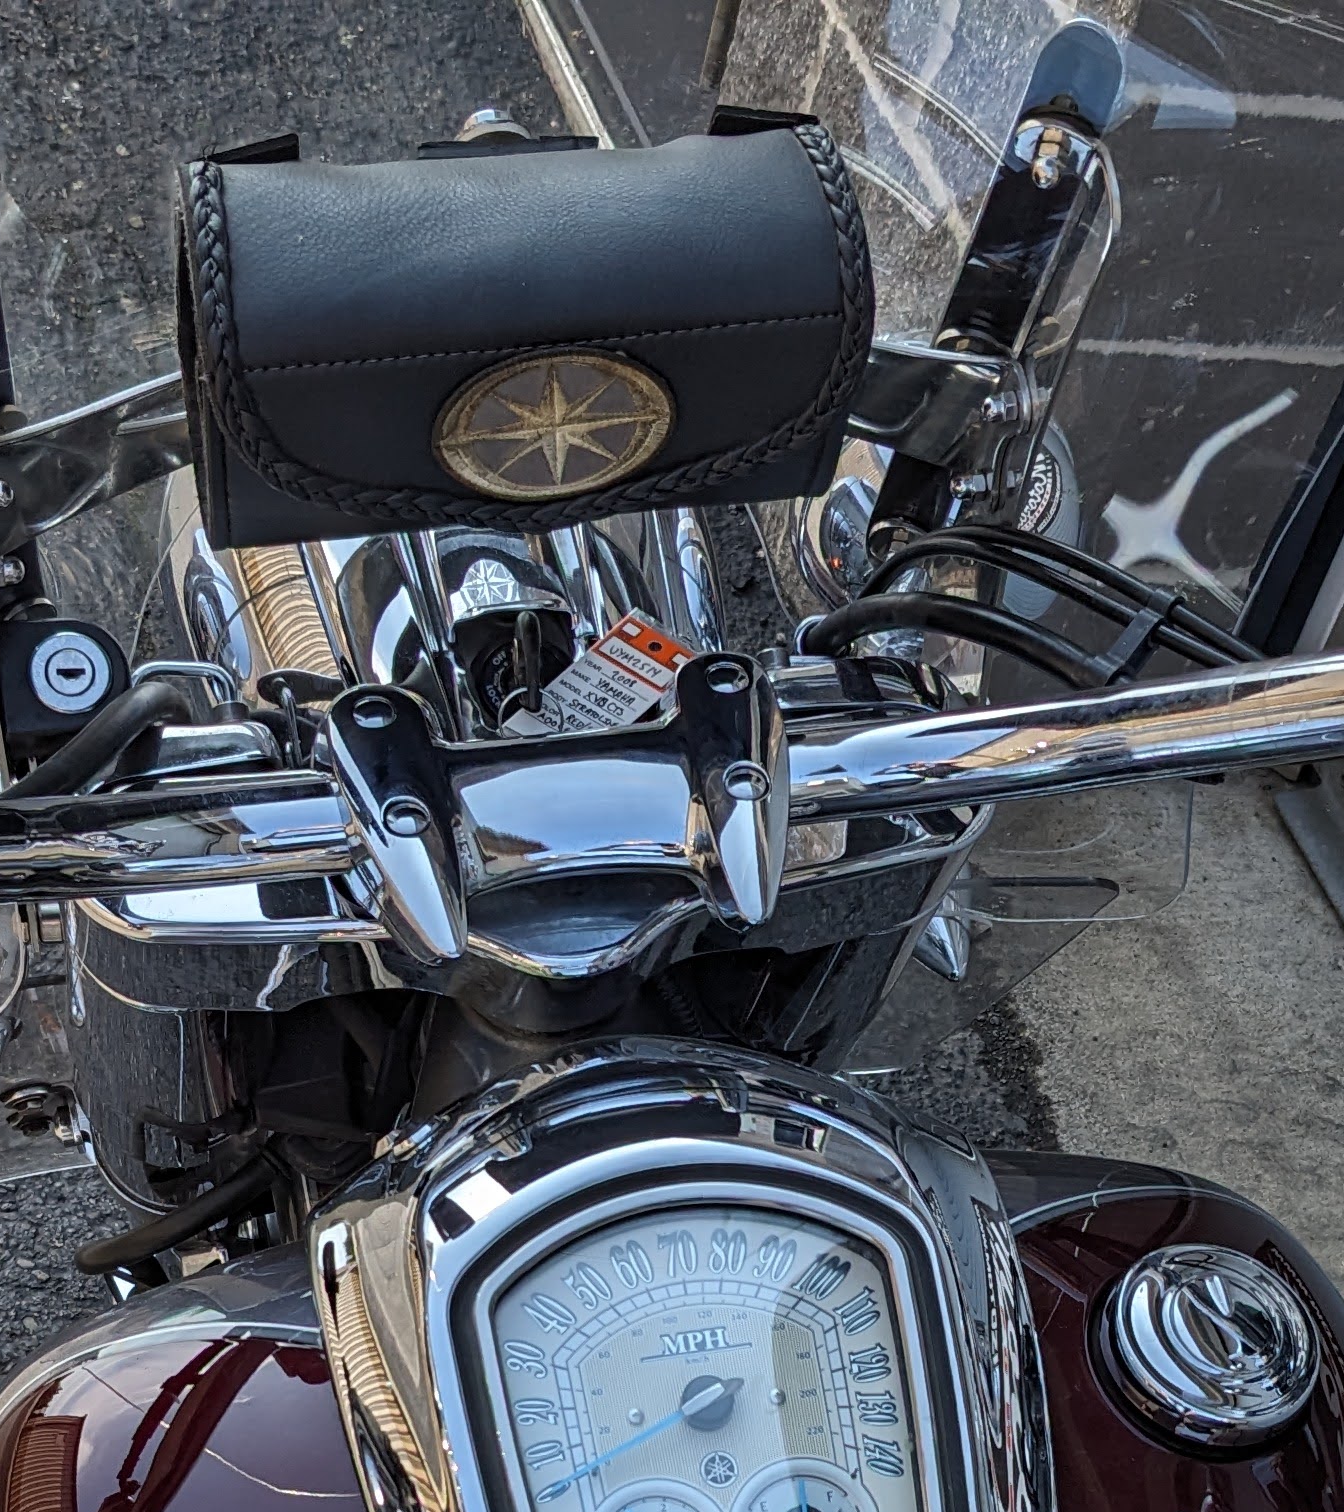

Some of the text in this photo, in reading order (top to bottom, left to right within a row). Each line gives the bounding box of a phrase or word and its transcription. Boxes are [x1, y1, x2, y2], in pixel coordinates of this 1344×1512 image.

[559, 679, 581, 696] MODEL
[571, 669, 636, 706] MAKE YAMAHA
[584, 659, 638, 688] YEAR 2008
[541, 703, 561, 717] OLOR
[610, 1240, 655, 1289] 60
[656, 1229, 698, 1279] 70
[707, 1228, 748, 1276] 80
[752, 1234, 798, 1283] 90
[560, 1262, 613, 1311] 50
[791, 1252, 852, 1301] 100
[520, 1292, 577, 1335] 40
[833, 1285, 881, 1336] 110
[503, 1339, 548, 1379] 30
[659, 1326, 729, 1356] MPH
[849, 1342, 892, 1384] 120
[799, 1388, 818, 1398] 200
[855, 1390, 899, 1427] 130
[514, 1398, 559, 1426] 20
[525, 1440, 566, 1471] 10
[862, 1434, 905, 1478] 140
[661, 1503, 667, 1512] 2
[760, 1501, 768, 1512] E
[826, 1490, 834, 1503] F
